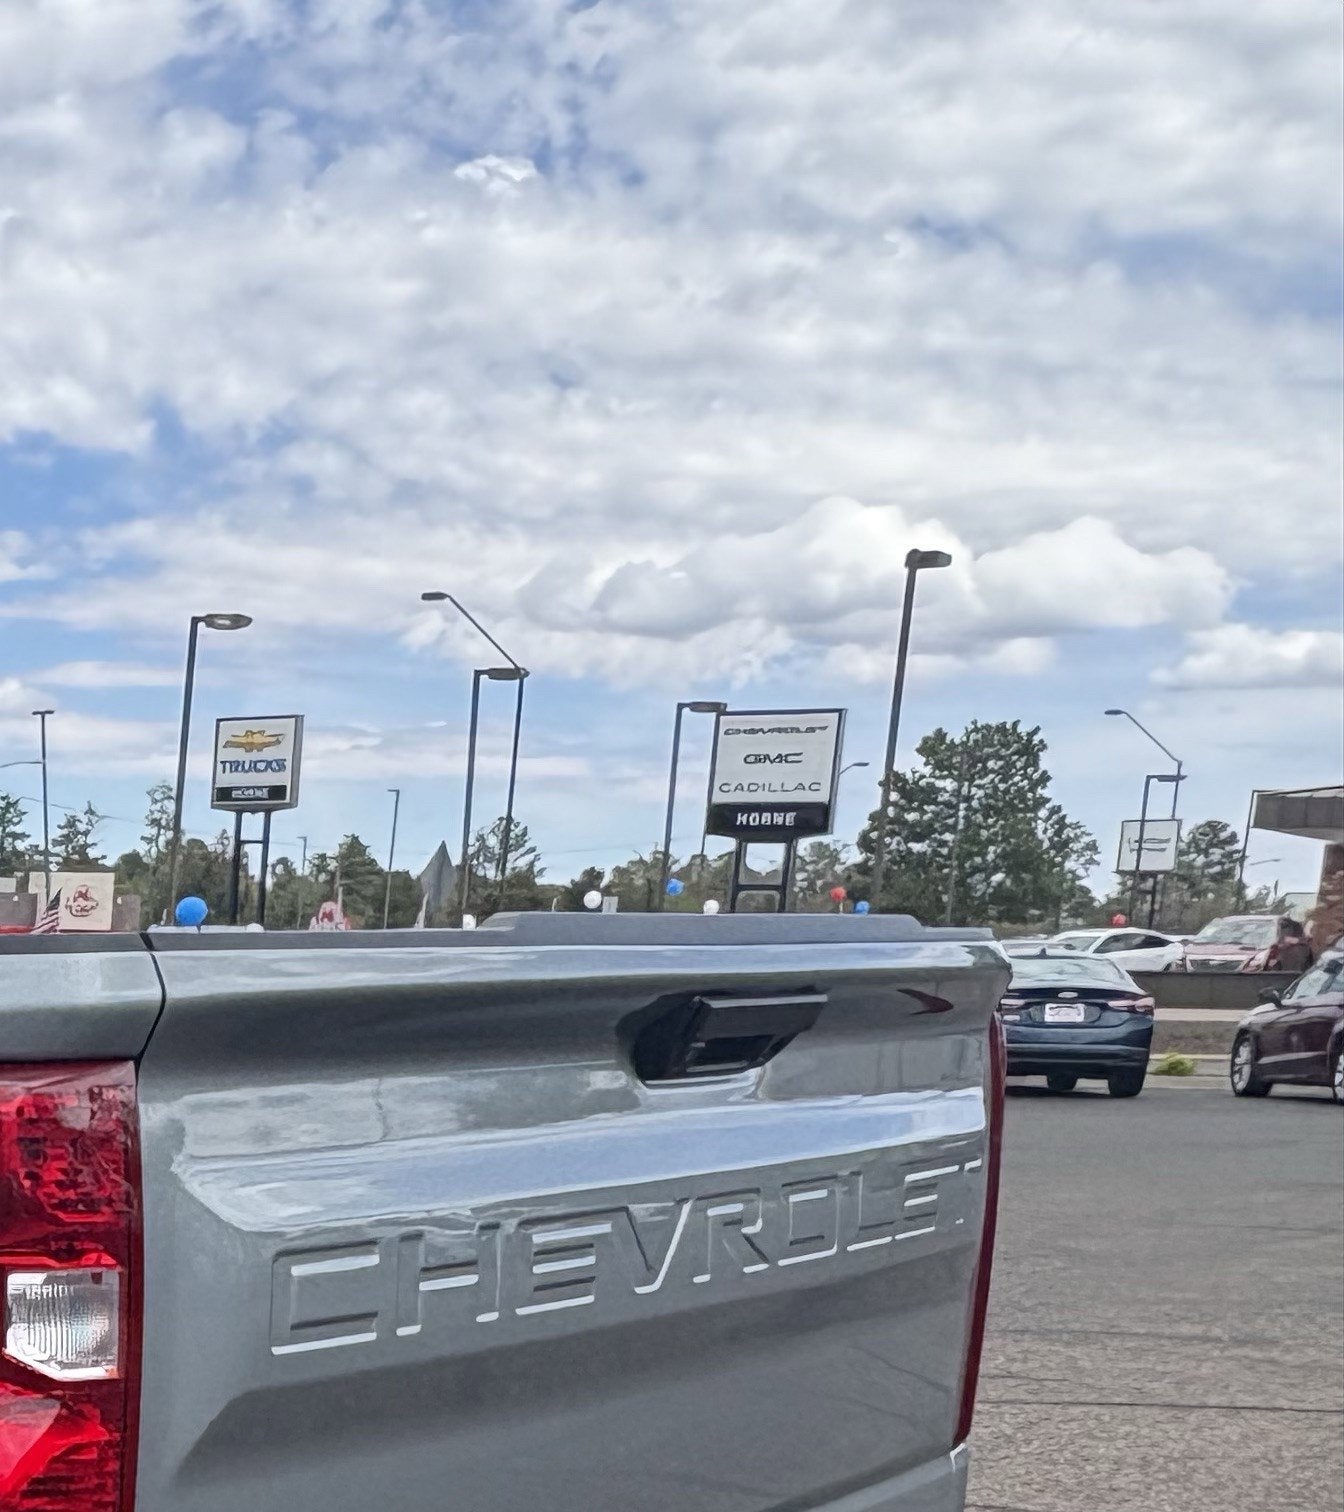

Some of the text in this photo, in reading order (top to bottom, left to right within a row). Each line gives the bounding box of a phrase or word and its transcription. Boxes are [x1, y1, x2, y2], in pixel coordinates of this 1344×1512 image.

[743, 752, 803, 765] GMC
[219, 758, 287, 775] TRUCKS
[718, 781, 821, 793] CADILLAC
[269, 1152, 983, 1356] CHEVROLET
